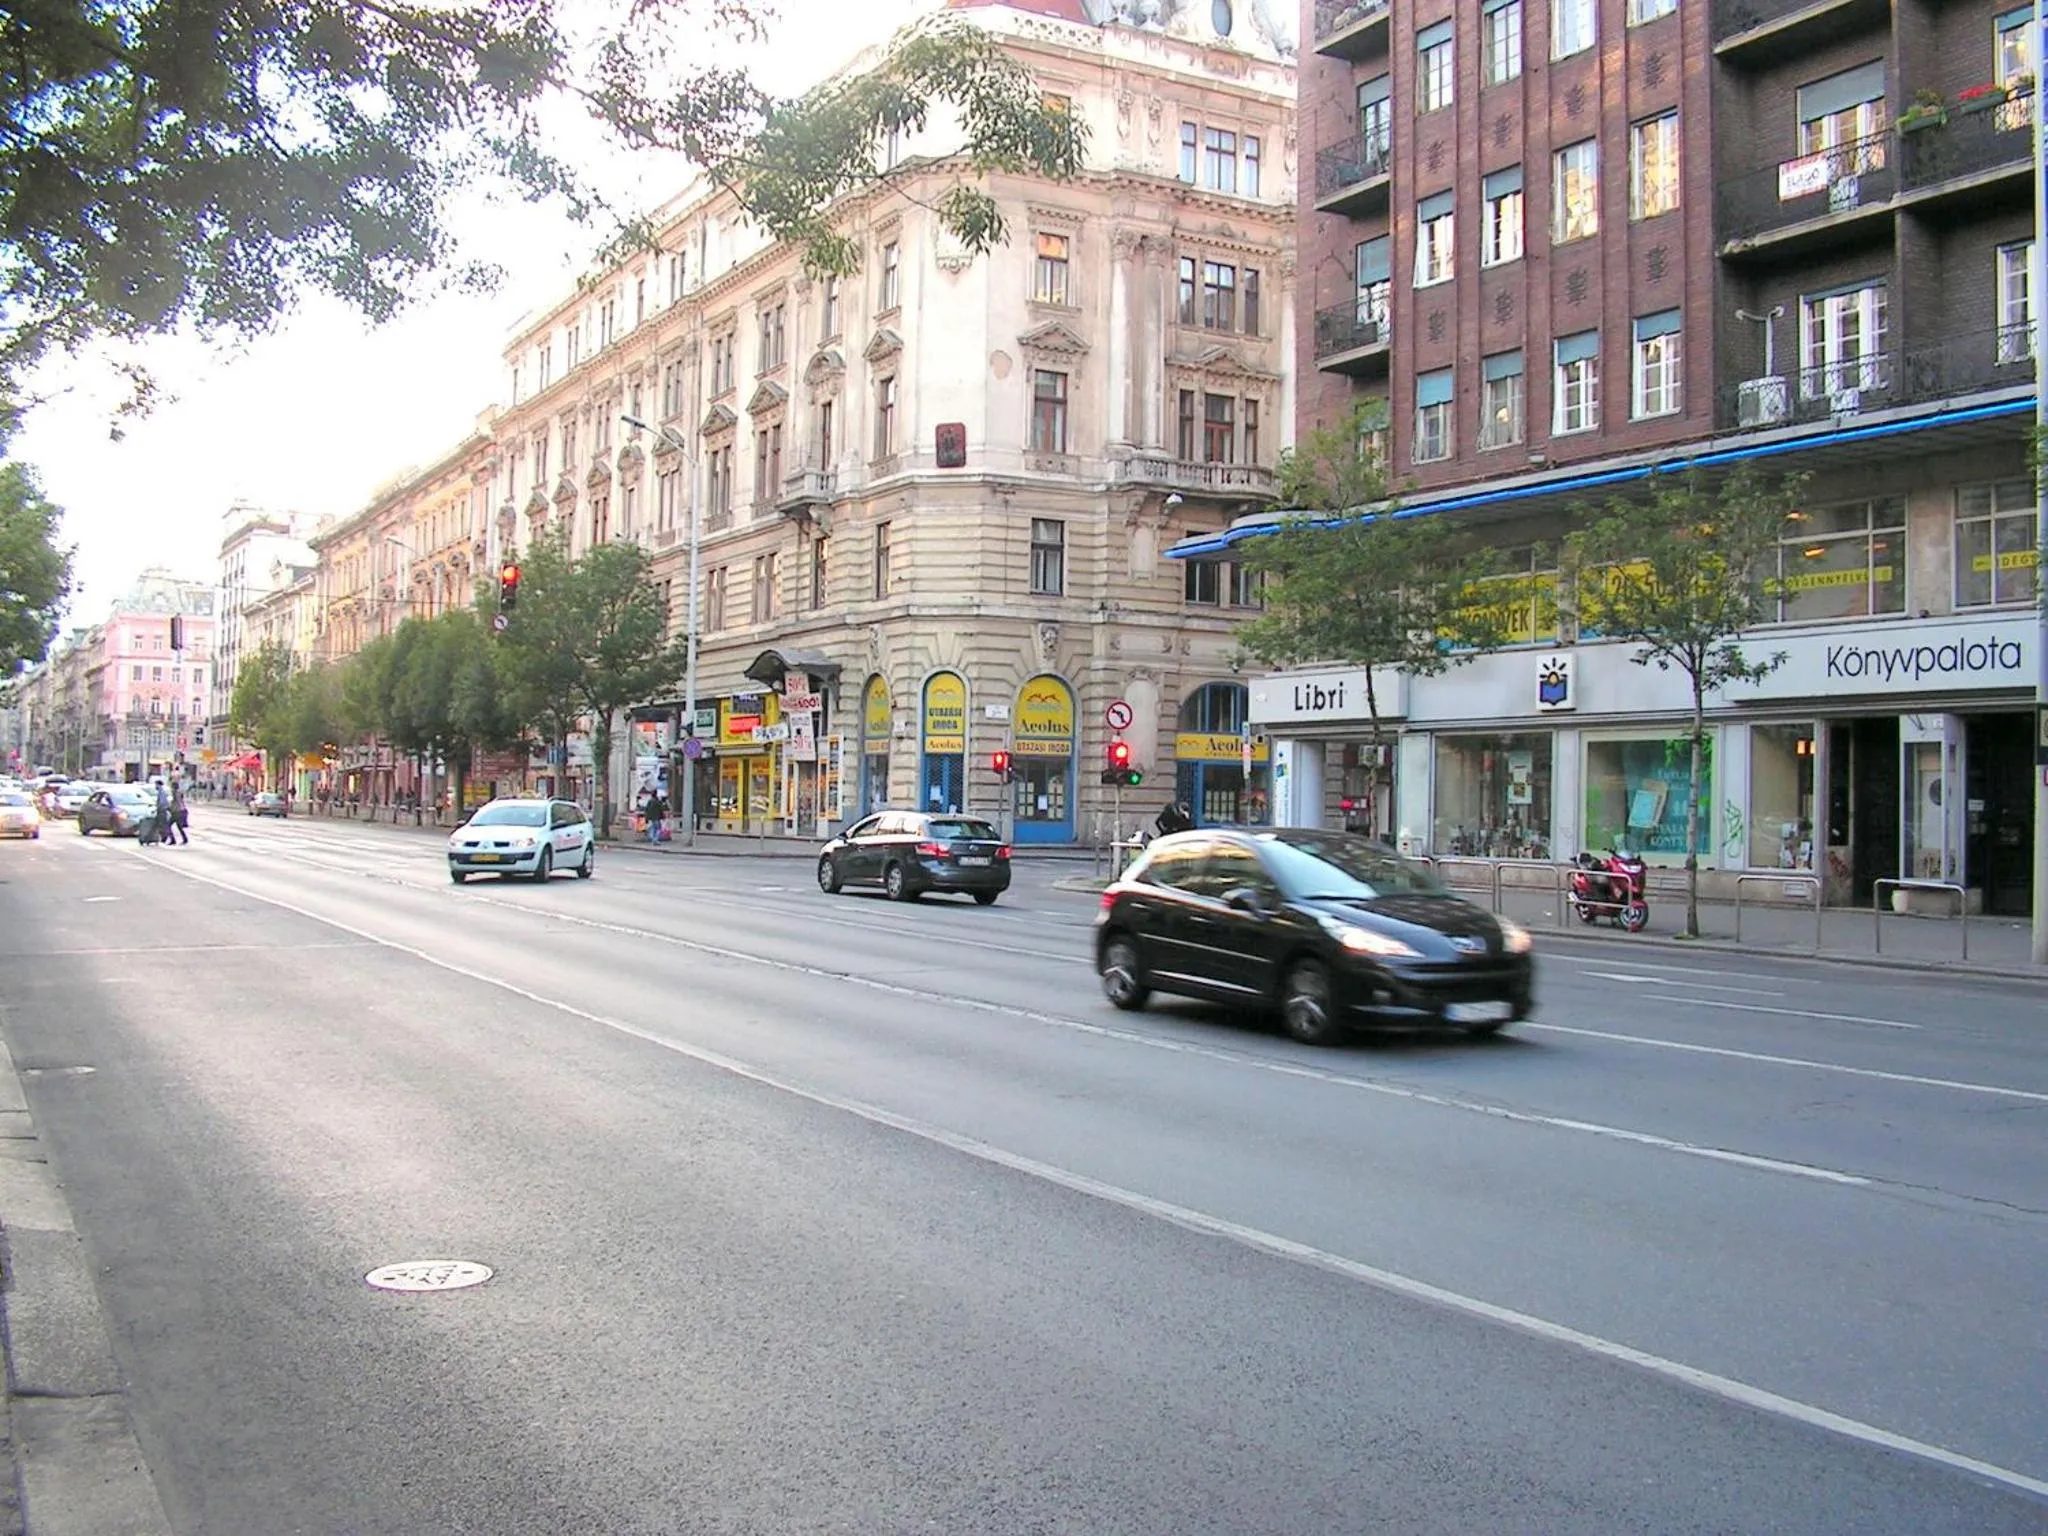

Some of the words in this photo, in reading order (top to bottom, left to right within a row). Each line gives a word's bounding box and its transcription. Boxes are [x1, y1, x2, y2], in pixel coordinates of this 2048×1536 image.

[1827, 635, 2022, 682] Könyvpalota
[1295, 681, 1344, 711] Libri
[1018, 719, 1070, 733] Aeolus
